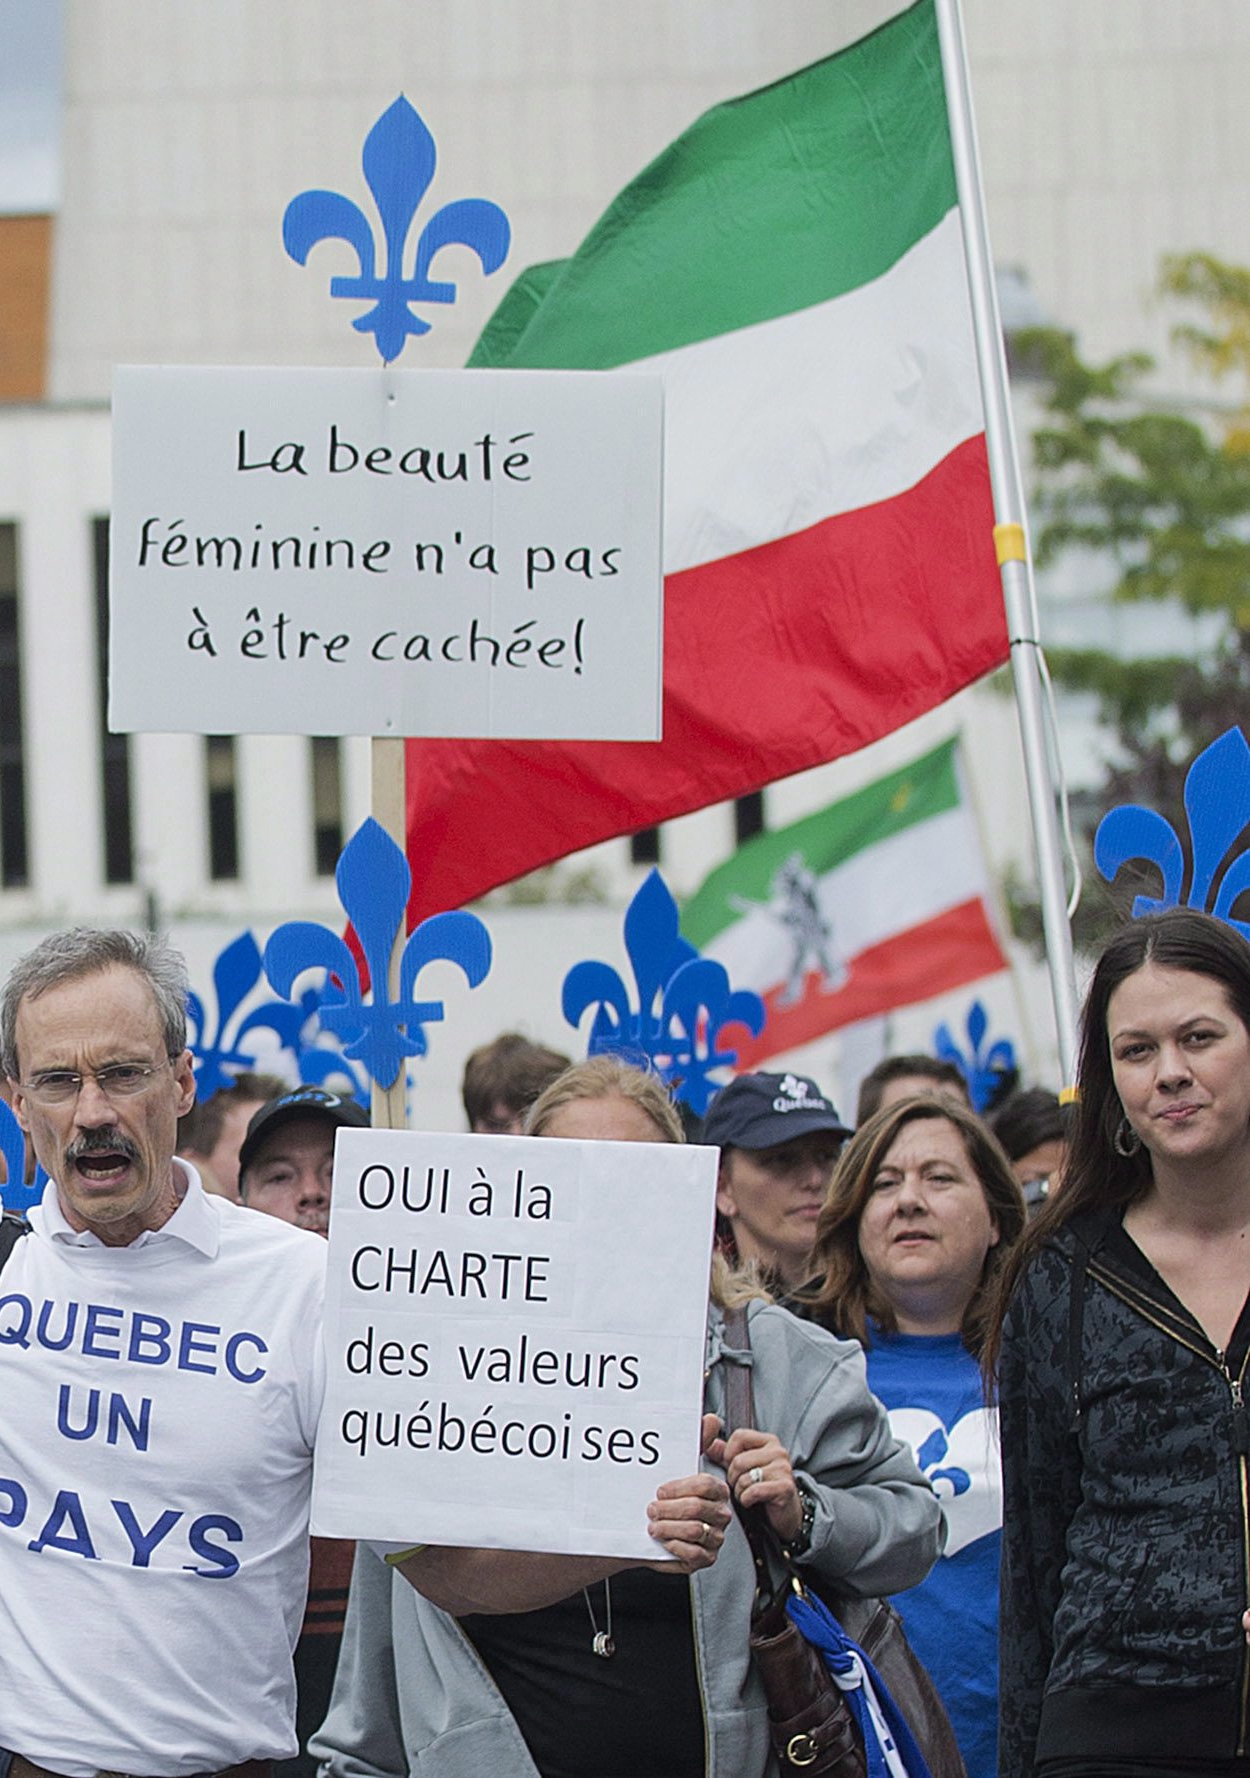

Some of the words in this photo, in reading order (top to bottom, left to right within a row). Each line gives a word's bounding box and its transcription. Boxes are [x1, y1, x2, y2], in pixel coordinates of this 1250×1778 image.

[237, 430, 308, 475] La
[328, 425, 534, 482] beauté
[138, 517, 391, 573] féminine
[415, 531, 498, 575] n'a
[526, 543, 622, 590] pas
[188, 607, 217, 657] à
[240, 607, 350, 663] être
[371, 618, 585, 675] cachée!
[358, 1164, 450, 1214] OUI
[468, 1167, 494, 1216] à
[513, 1170, 553, 1220] la
[351, 1245, 550, 1302] CHARTE
[346, 1326, 430, 1377] des
[458, 1335, 640, 1391] valeurs
[57, 1384, 152, 1452] UN
[341, 1401, 661, 1466] québécoises
